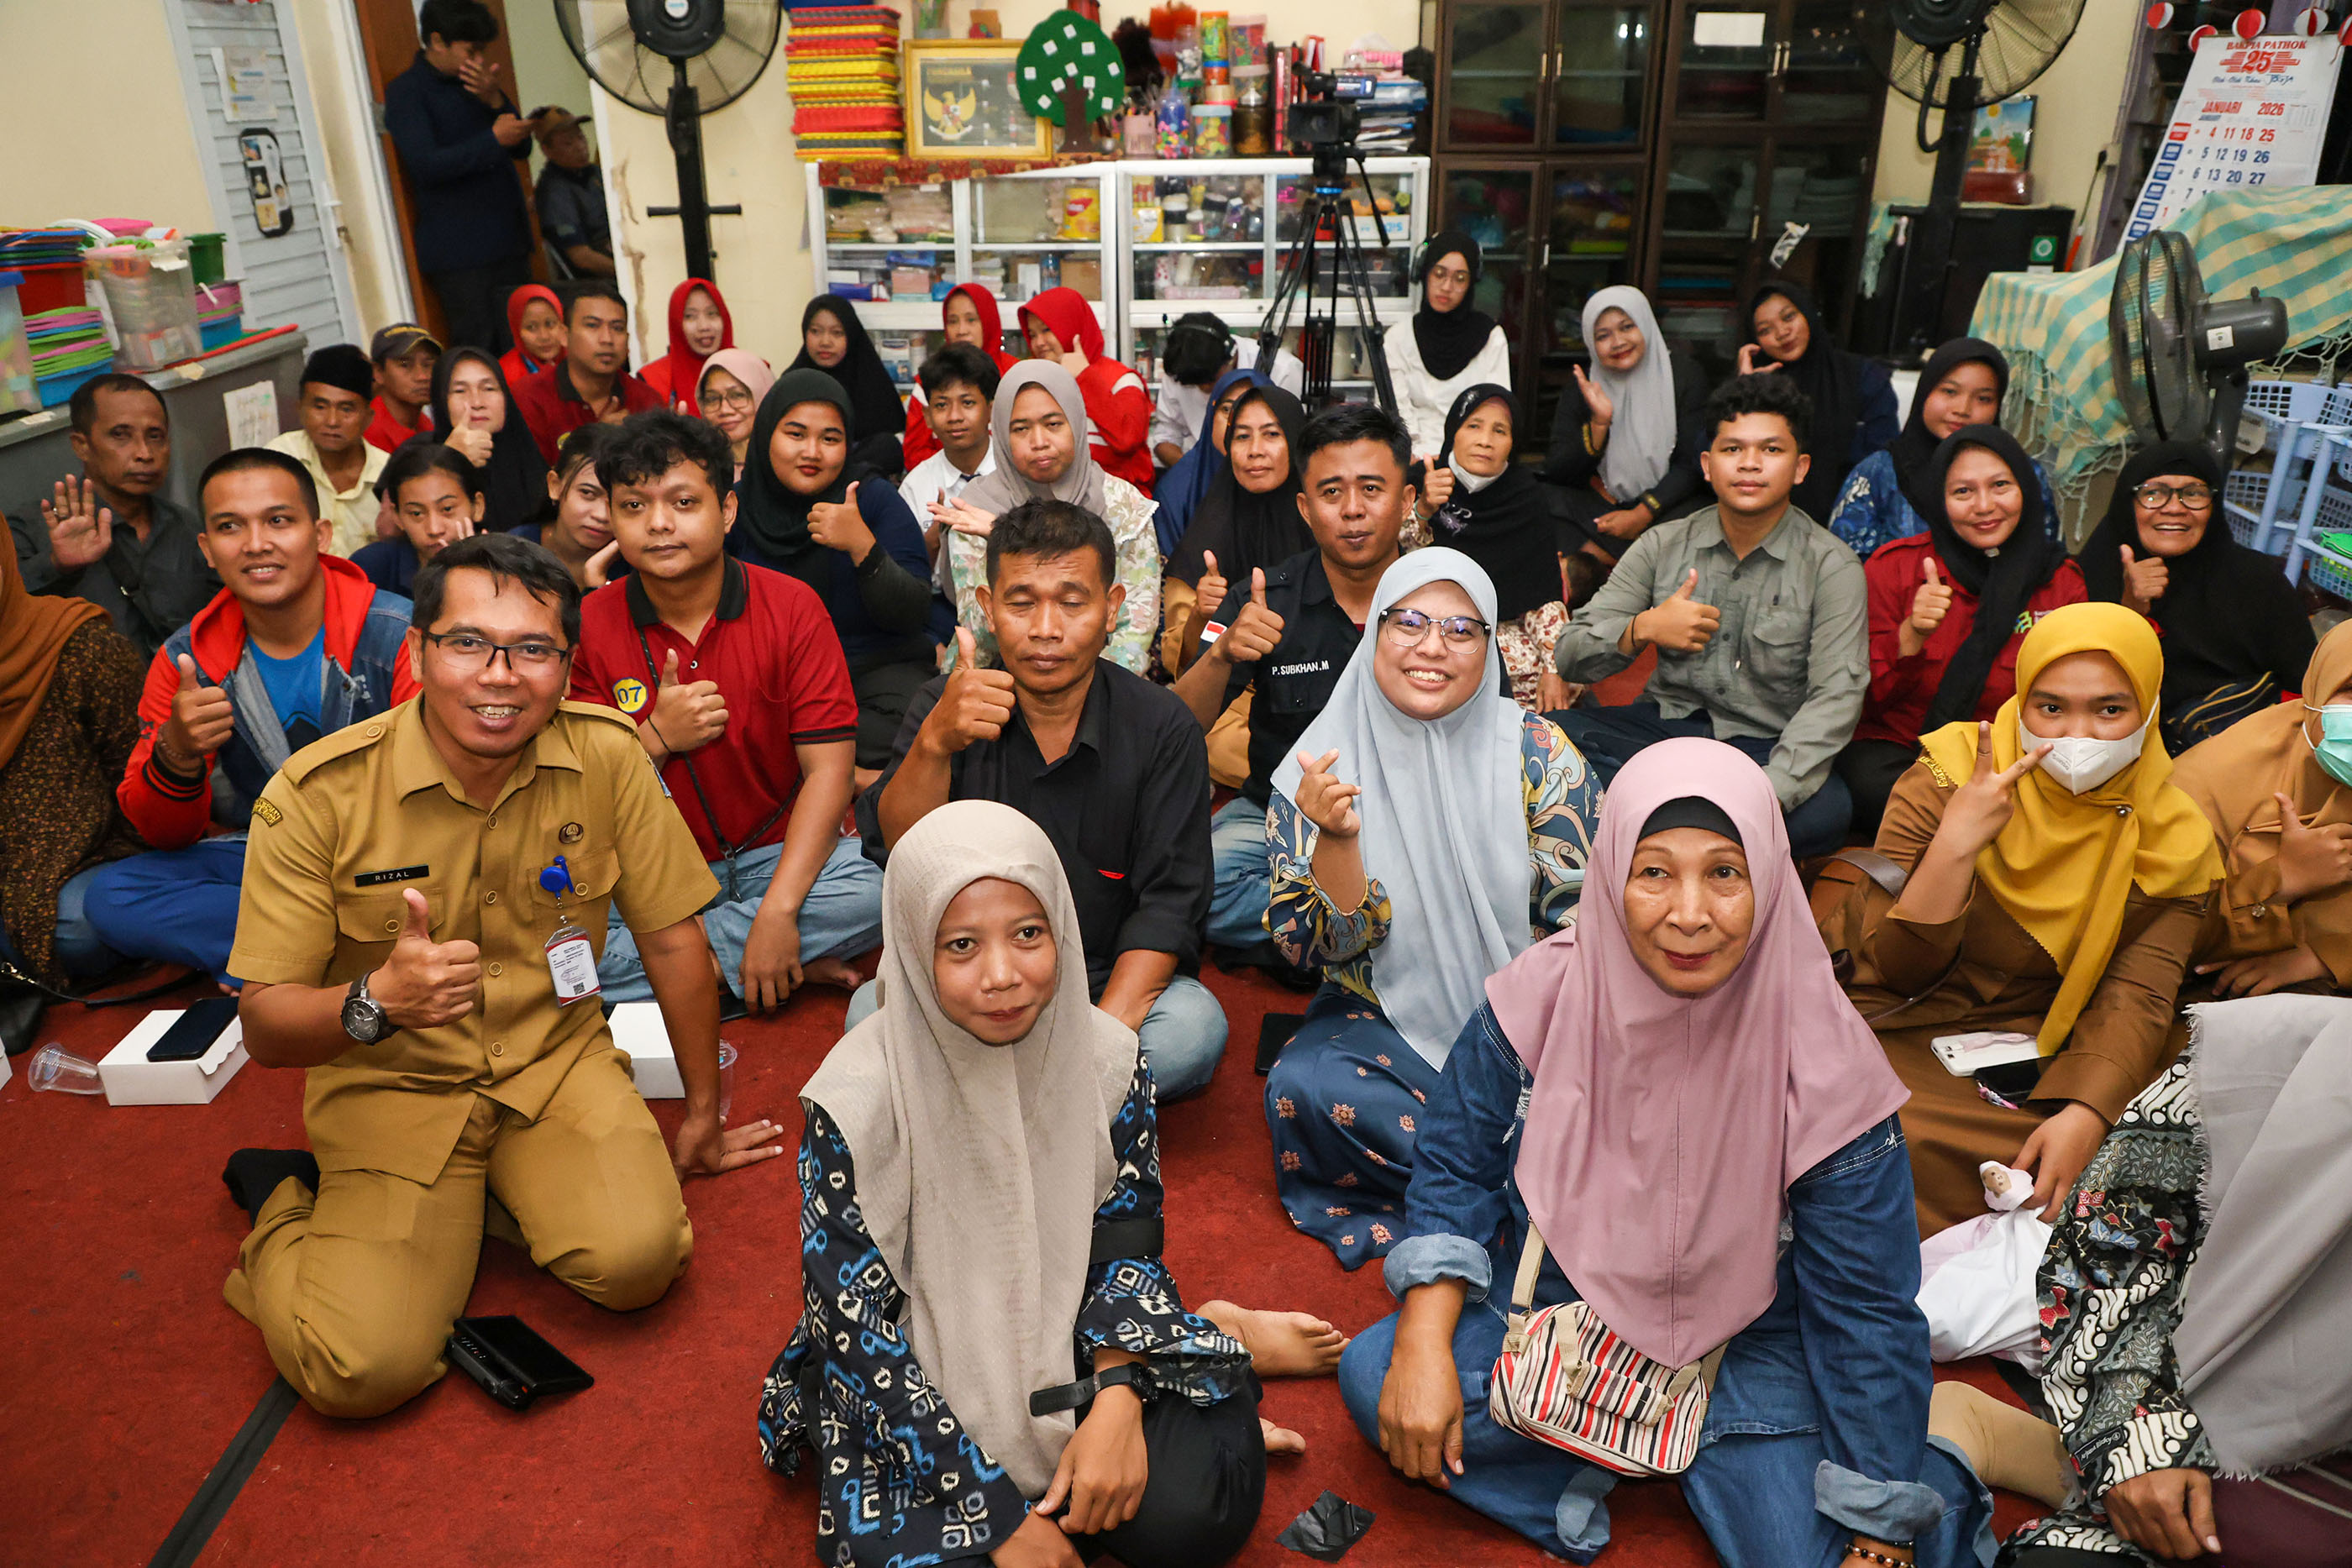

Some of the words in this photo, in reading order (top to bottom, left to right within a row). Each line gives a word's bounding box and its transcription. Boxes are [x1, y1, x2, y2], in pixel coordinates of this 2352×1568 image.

[2242, 50, 2276, 73] 25
[2202, 101, 2243, 113] JANUARI
[2257, 102, 2285, 116] 2026
[2209, 127, 2217, 138] 4
[2224, 128, 2235, 139] 11
[2240, 128, 2255, 140] 18
[2259, 128, 2276, 142] 25
[2201, 147, 2209, 159] 5
[2216, 148, 2228, 160] 12
[2234, 149, 2247, 161] 19
[2253, 150, 2270, 163] 26
[2192, 167, 2201, 179] 6
[2208, 169, 2220, 181] 13
[2226, 170, 2242, 183] 20
[2249, 172, 2265, 185] 27
[2186, 188, 2193, 199] 7
[1272, 659, 1330, 675] P.SUBKHAN.M
[617, 685, 642, 704] 07
[375, 871, 409, 881] RIZAL
